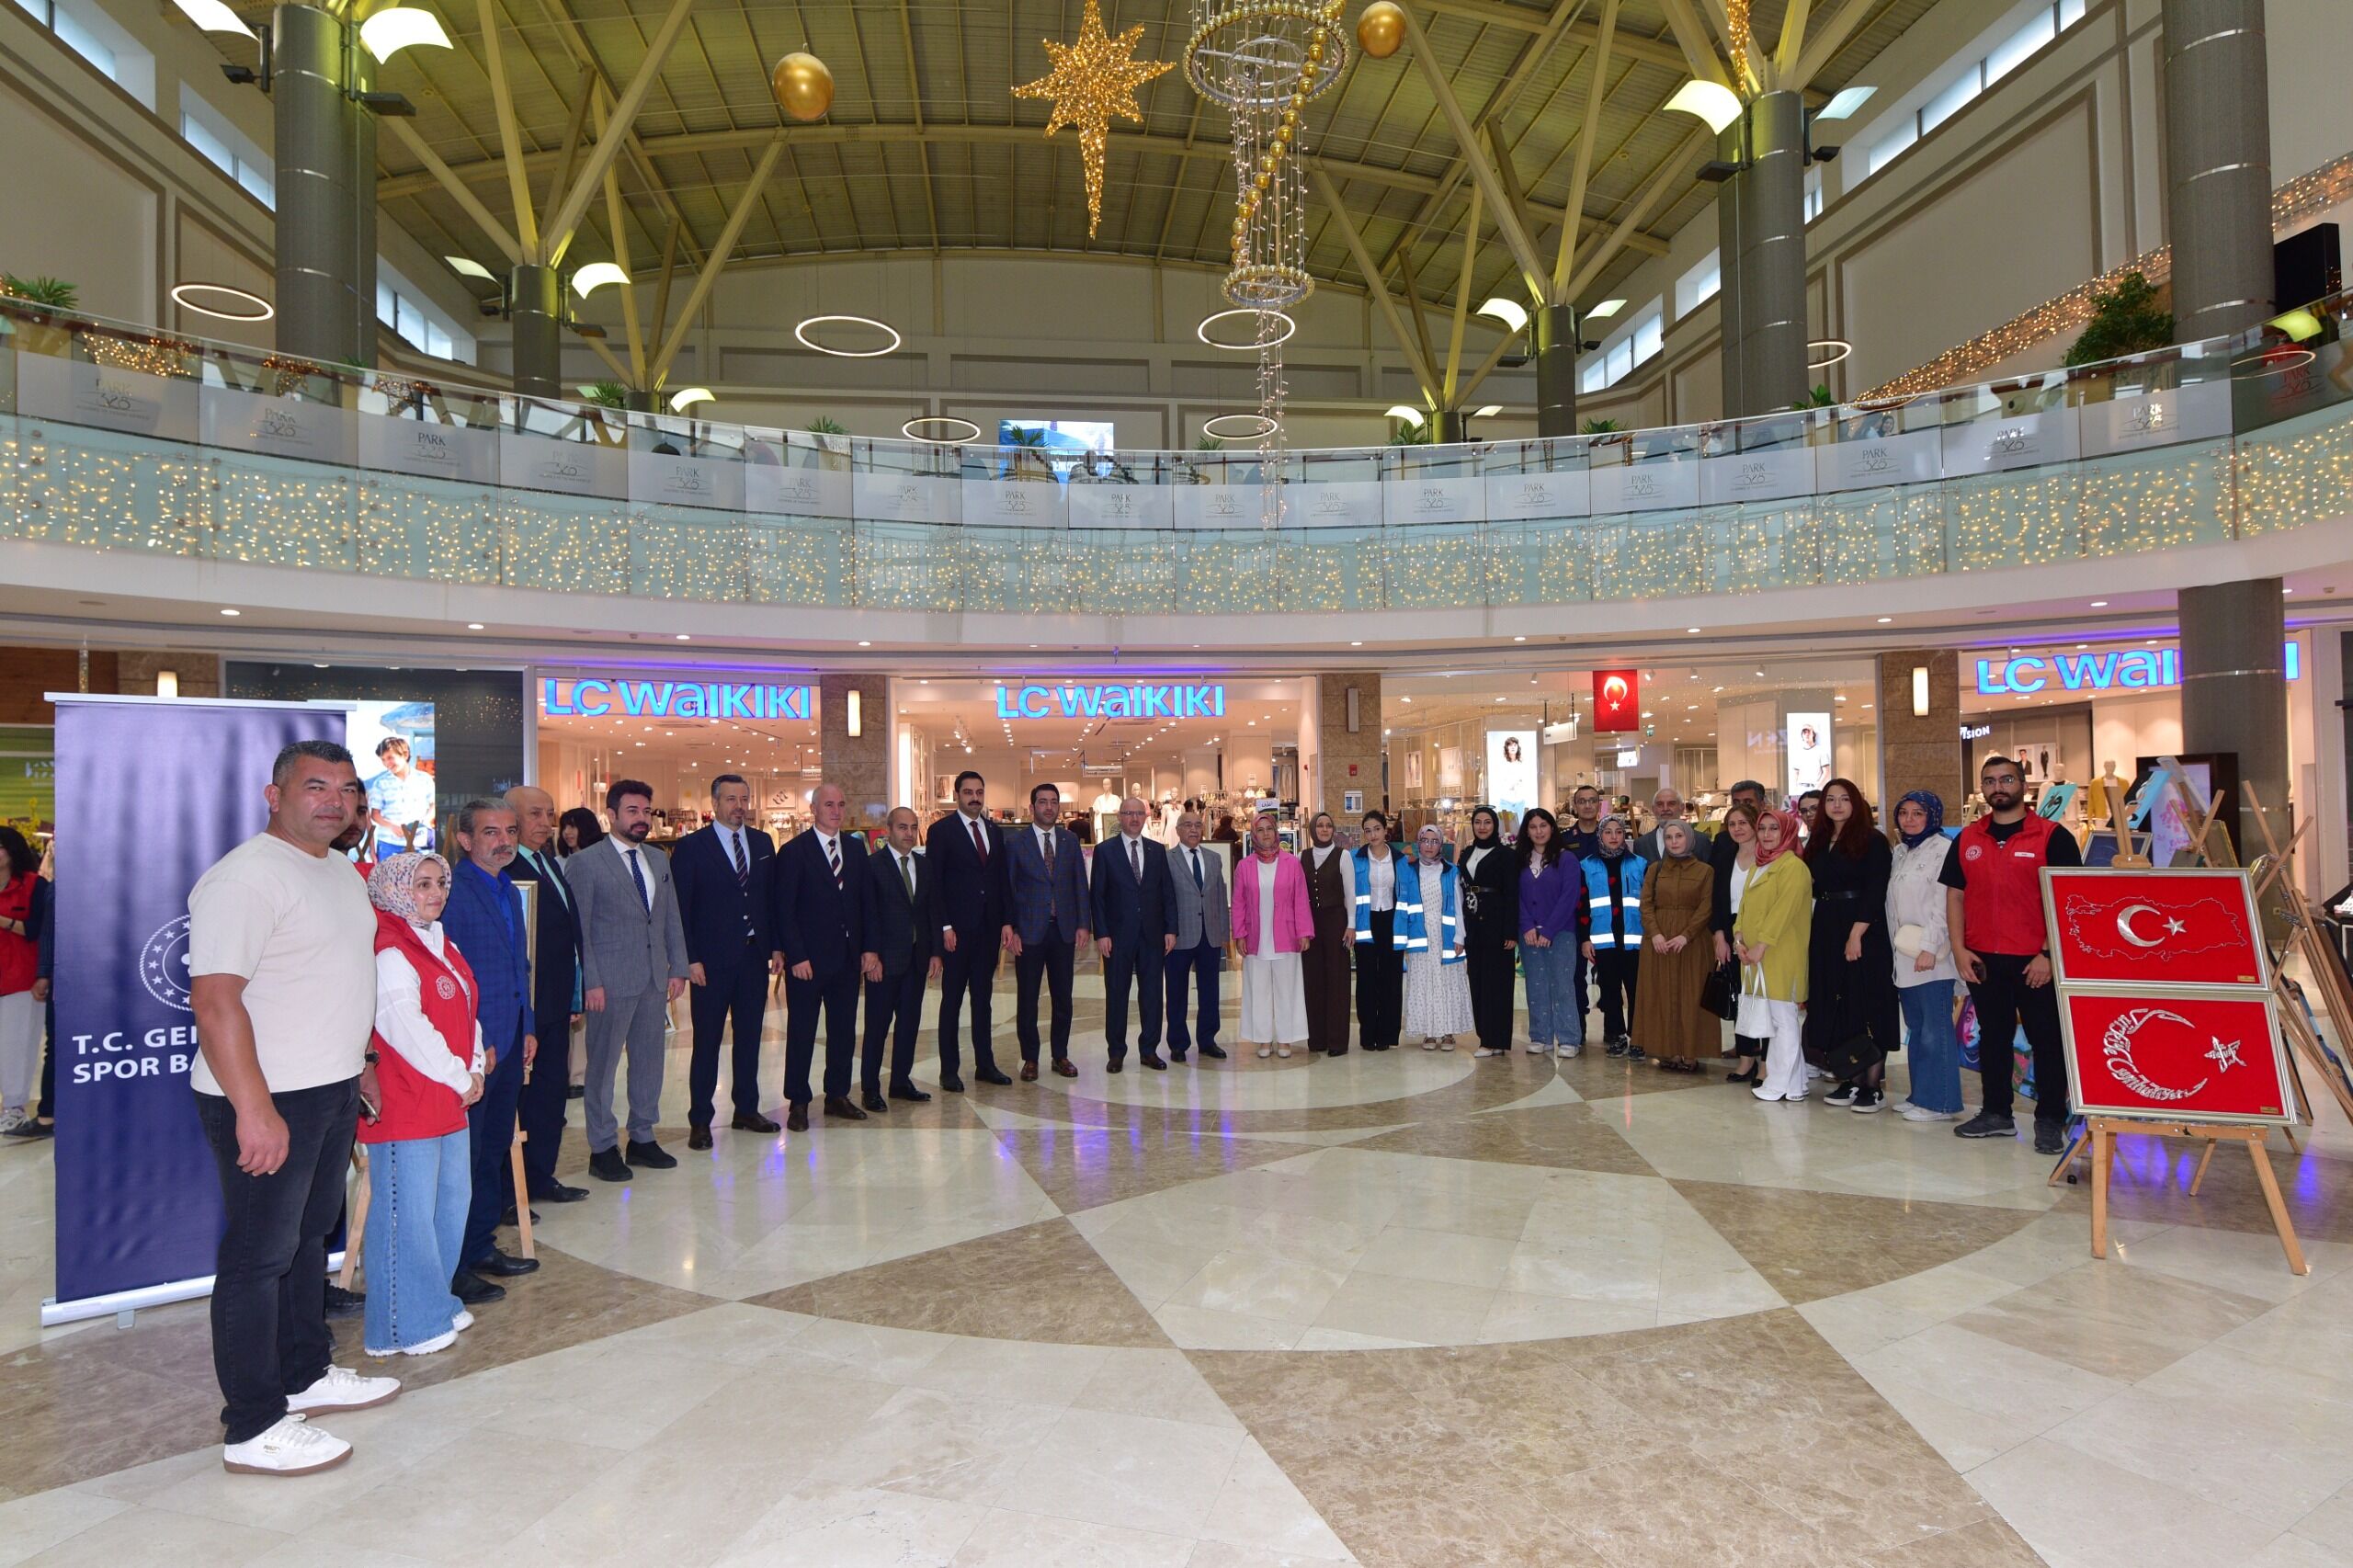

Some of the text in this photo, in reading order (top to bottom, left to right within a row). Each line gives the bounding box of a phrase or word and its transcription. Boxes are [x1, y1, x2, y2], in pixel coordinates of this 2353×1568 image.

[418, 432, 446, 447] PARK
[1862, 448, 1888, 460] PARK
[676, 466, 699, 478] PARK
[1743, 462, 1766, 473] PARK
[1631, 474, 1654, 485] PARK
[1424, 488, 1443, 498] PARK
[1524, 483, 1545, 493] PARK
[1006, 490, 1025, 501] PARK
[1216, 494, 1235, 503] PARK
[1321, 492, 1339, 501] PARK
[1976, 654, 2047, 695] LC
[544, 678, 611, 717] LC
[996, 686, 1051, 719] LC
[72, 1031, 133, 1055] T.C.
[73, 1059, 160, 1084] SPOR
